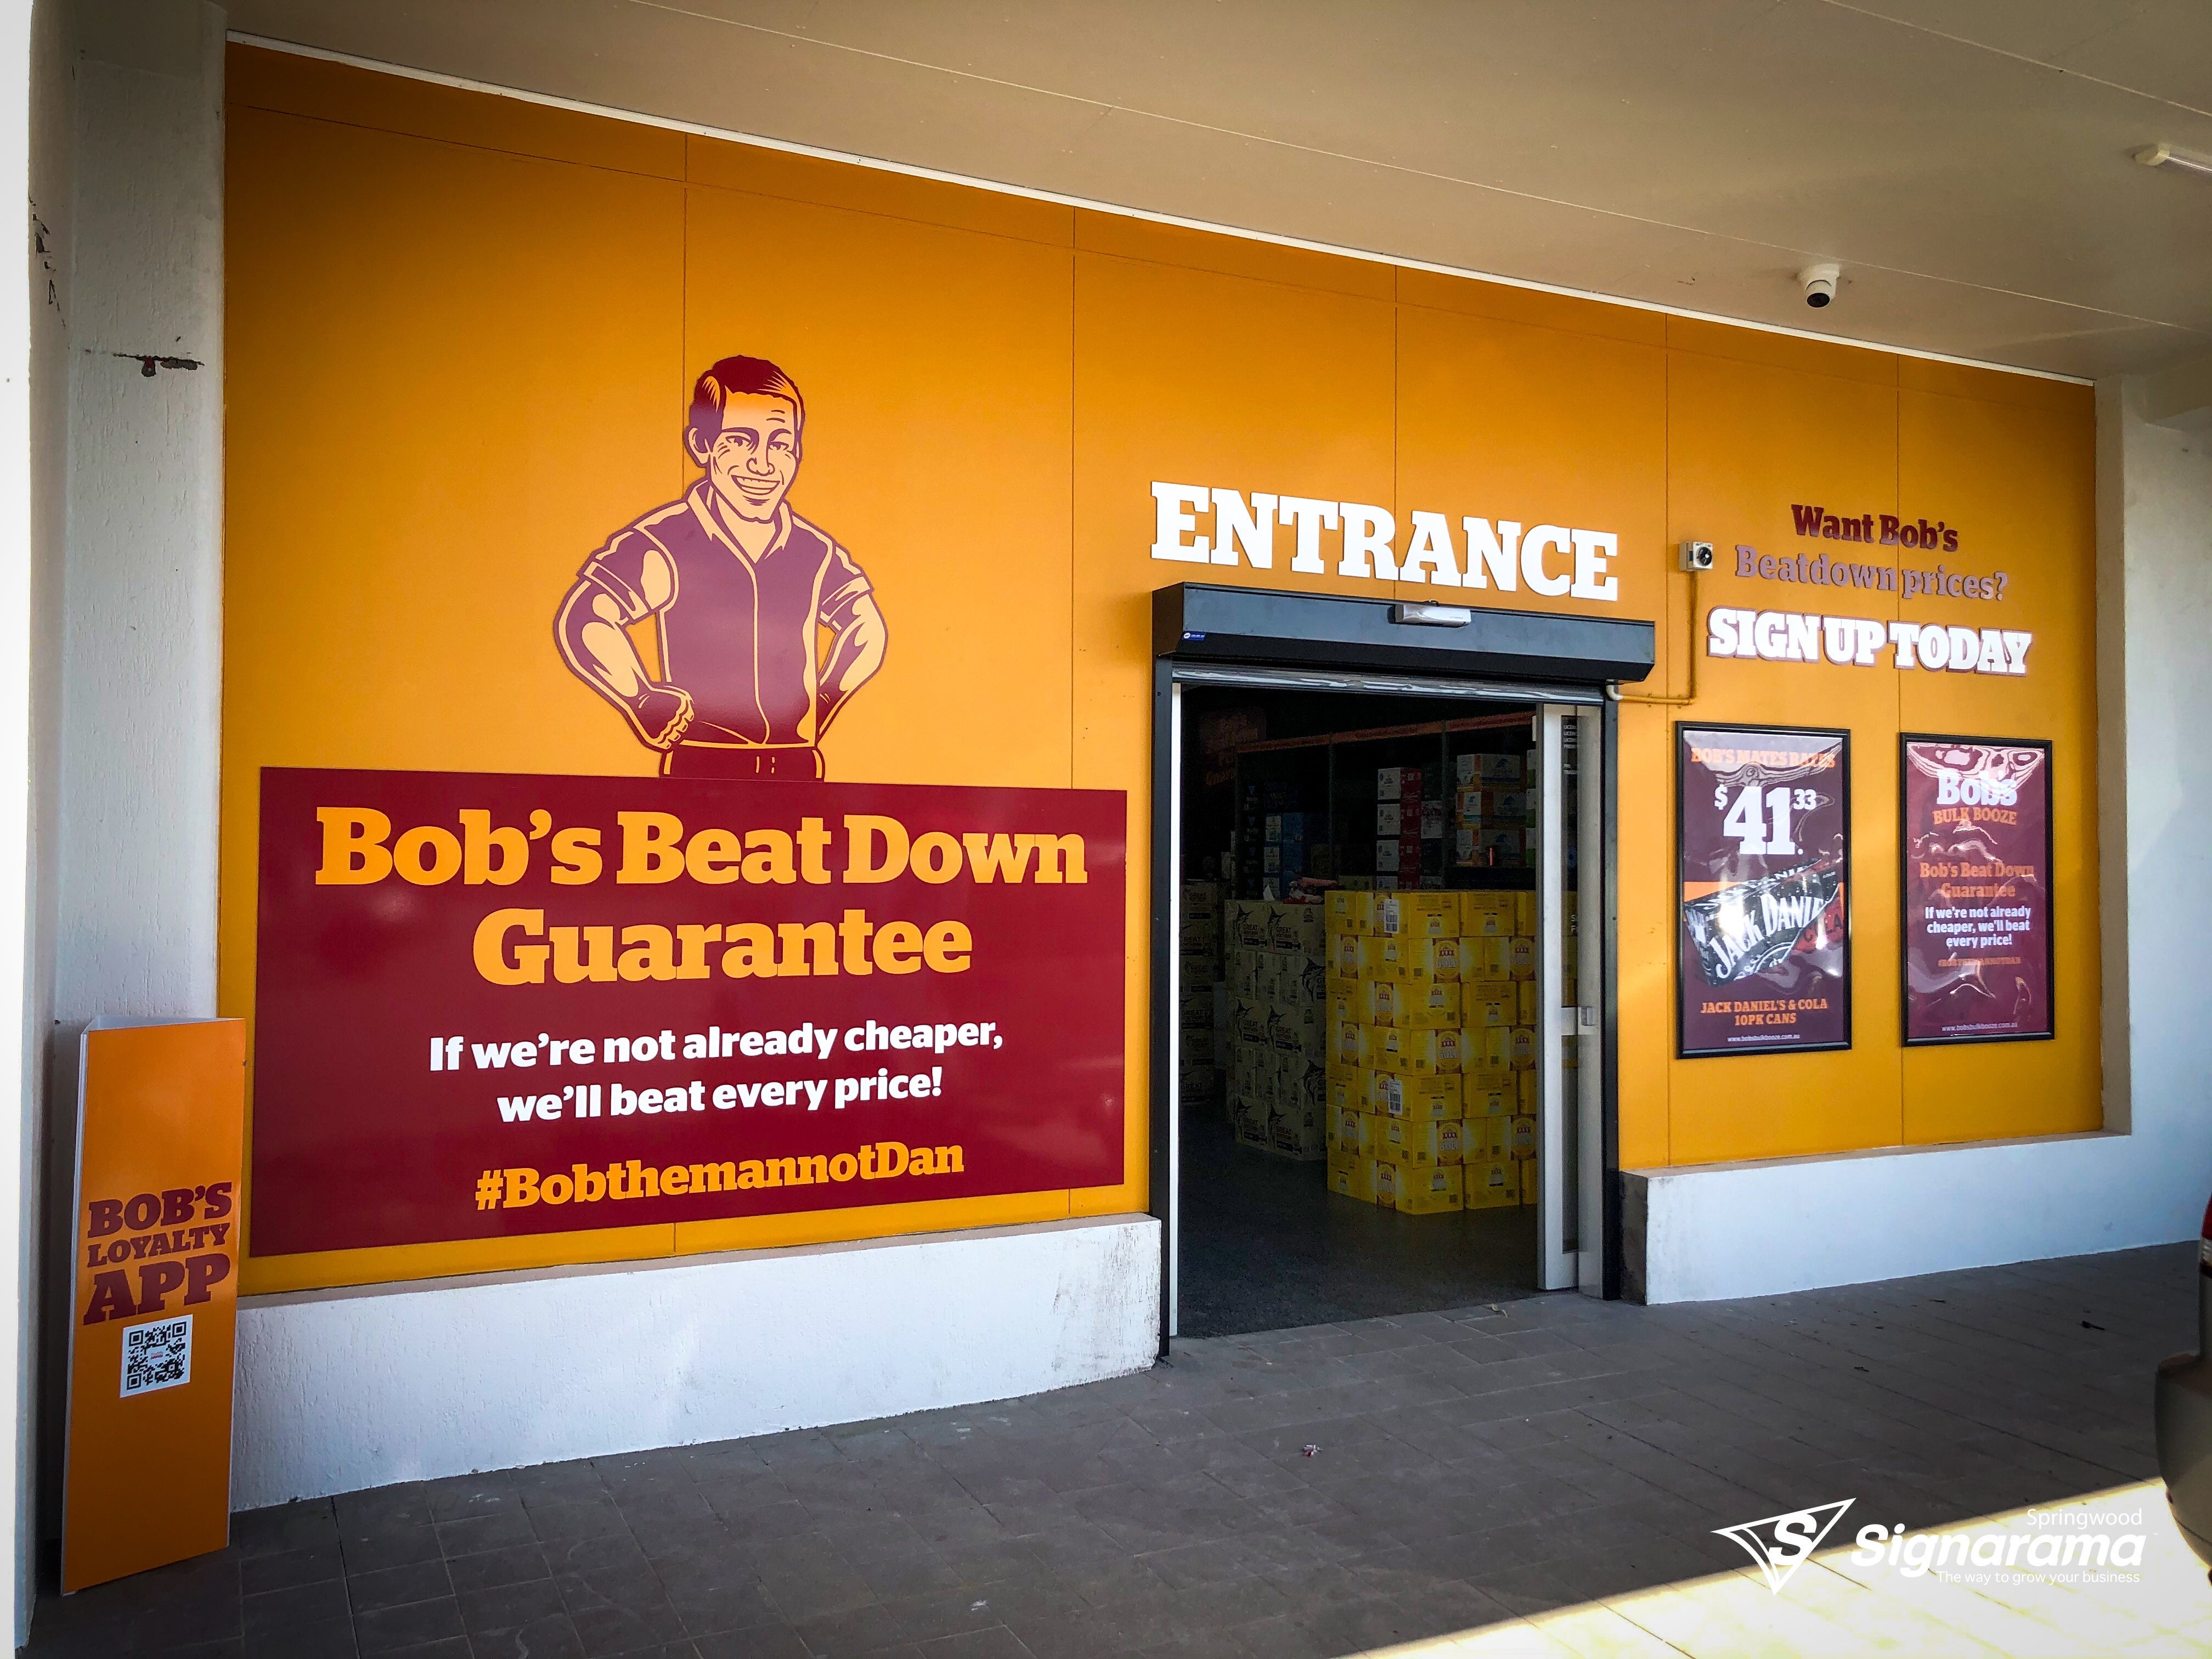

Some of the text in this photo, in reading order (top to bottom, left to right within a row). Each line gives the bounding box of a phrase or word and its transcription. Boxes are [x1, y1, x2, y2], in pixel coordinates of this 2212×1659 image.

[1149, 481, 1618, 602] ENTRANCE
[1791, 504, 1959, 552] Want Bob's
[1735, 544, 2008, 601] Beatdown prices?
[1707, 606, 2033, 677] SIGN UP TODAY
[1736, 749, 1788, 766] MATES
[1932, 806, 2018, 826] BULK BOOZE
[315, 806, 1088, 886] Bob's Beat Down
[1920, 862, 2034, 878] Bob's Beat Down
[1925, 905, 2032, 919] If we're not already
[1942, 883, 2016, 898] Guarantee
[473, 908, 973, 986] Guarantee
[1927, 919, 2030, 935] cheaper, we'll beat
[1946, 934, 2013, 949] every price!
[1701, 998, 1828, 1013] JACK DANIEL'S & COLA
[1735, 1013, 1797, 1026] 10PK CANS
[430, 1019, 1003, 1071] If we're not already cheaper,
[497, 1066, 943, 1123] we'll beat every price!
[475, 1141, 964, 1211] #BobthemannotDan
[87, 1181, 233, 1239] BOB'S
[87, 1222, 231, 1268] LOYALTY
[83, 1252, 230, 1326] APP
